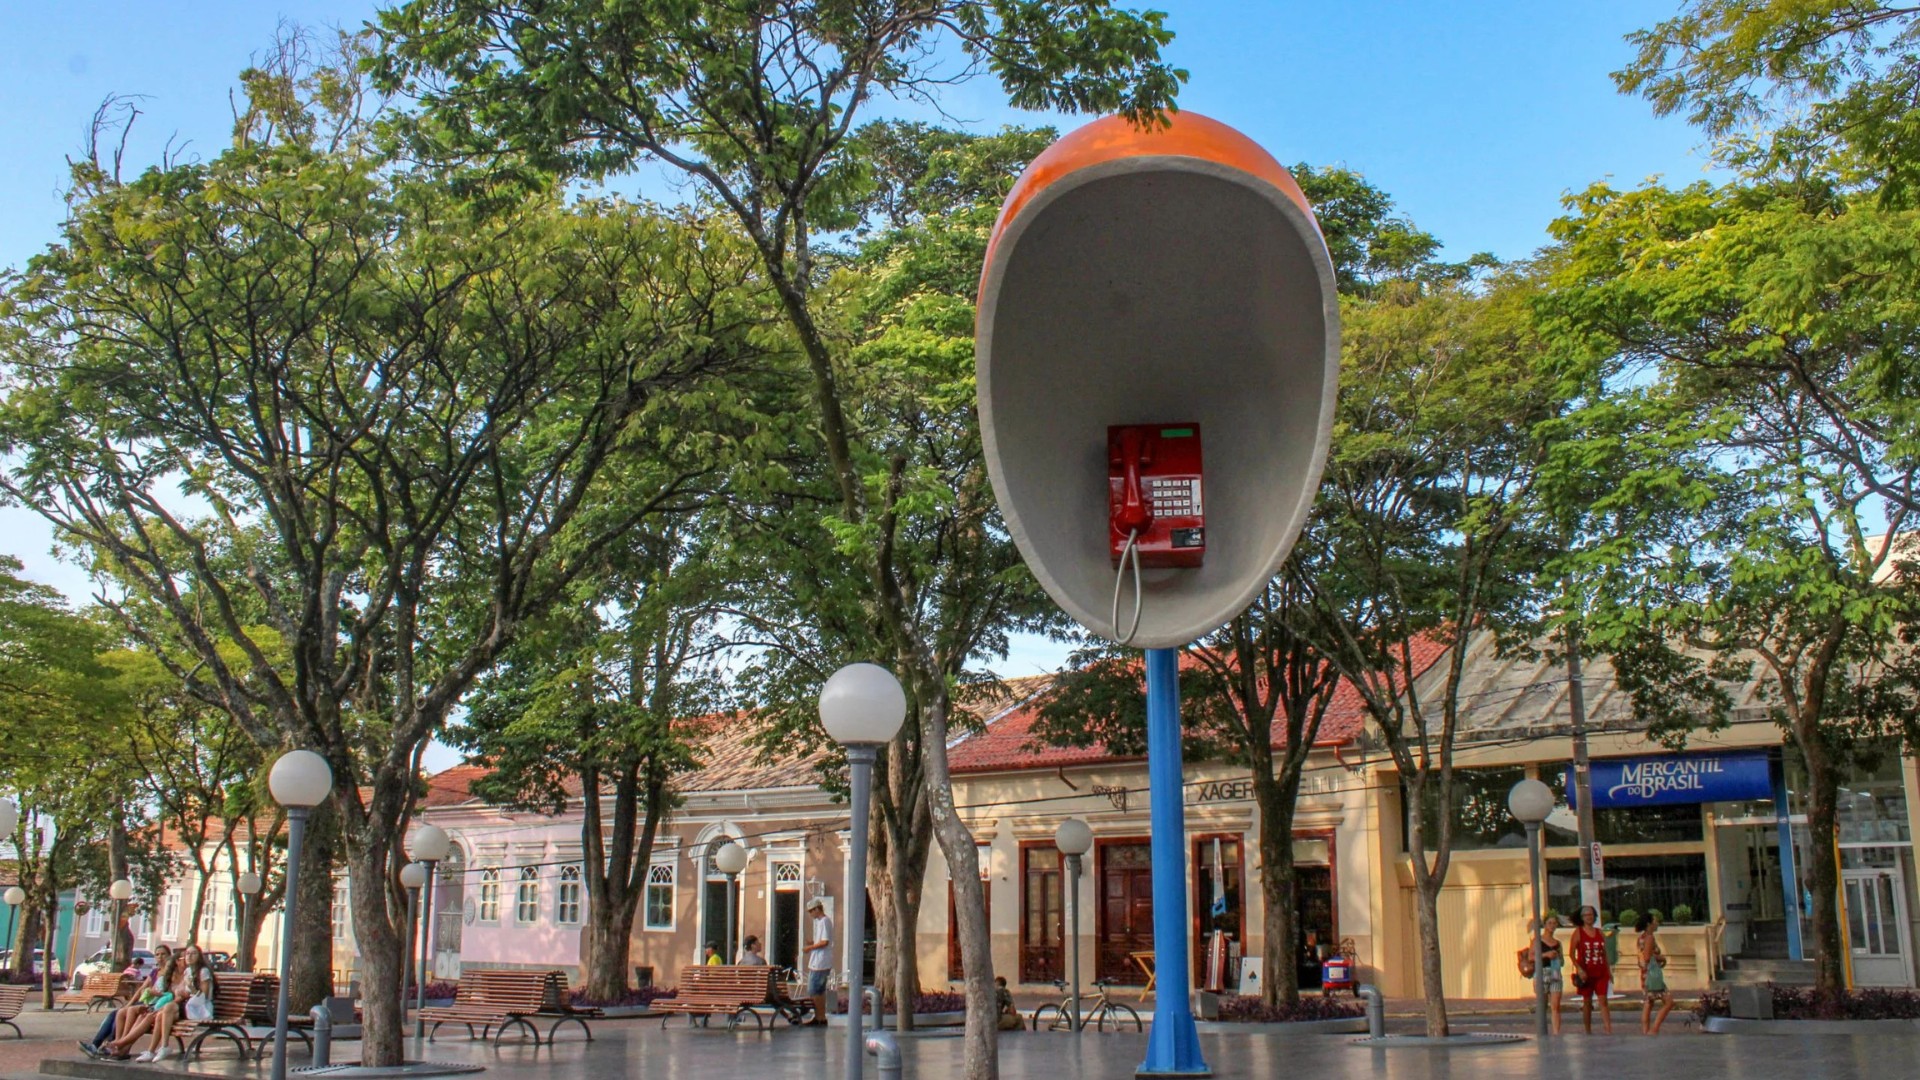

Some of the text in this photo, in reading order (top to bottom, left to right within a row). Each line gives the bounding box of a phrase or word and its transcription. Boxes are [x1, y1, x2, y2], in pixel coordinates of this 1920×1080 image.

[1621, 758, 1724, 786] MERCANTIL
[1627, 774, 1704, 799] DO BRASIL
